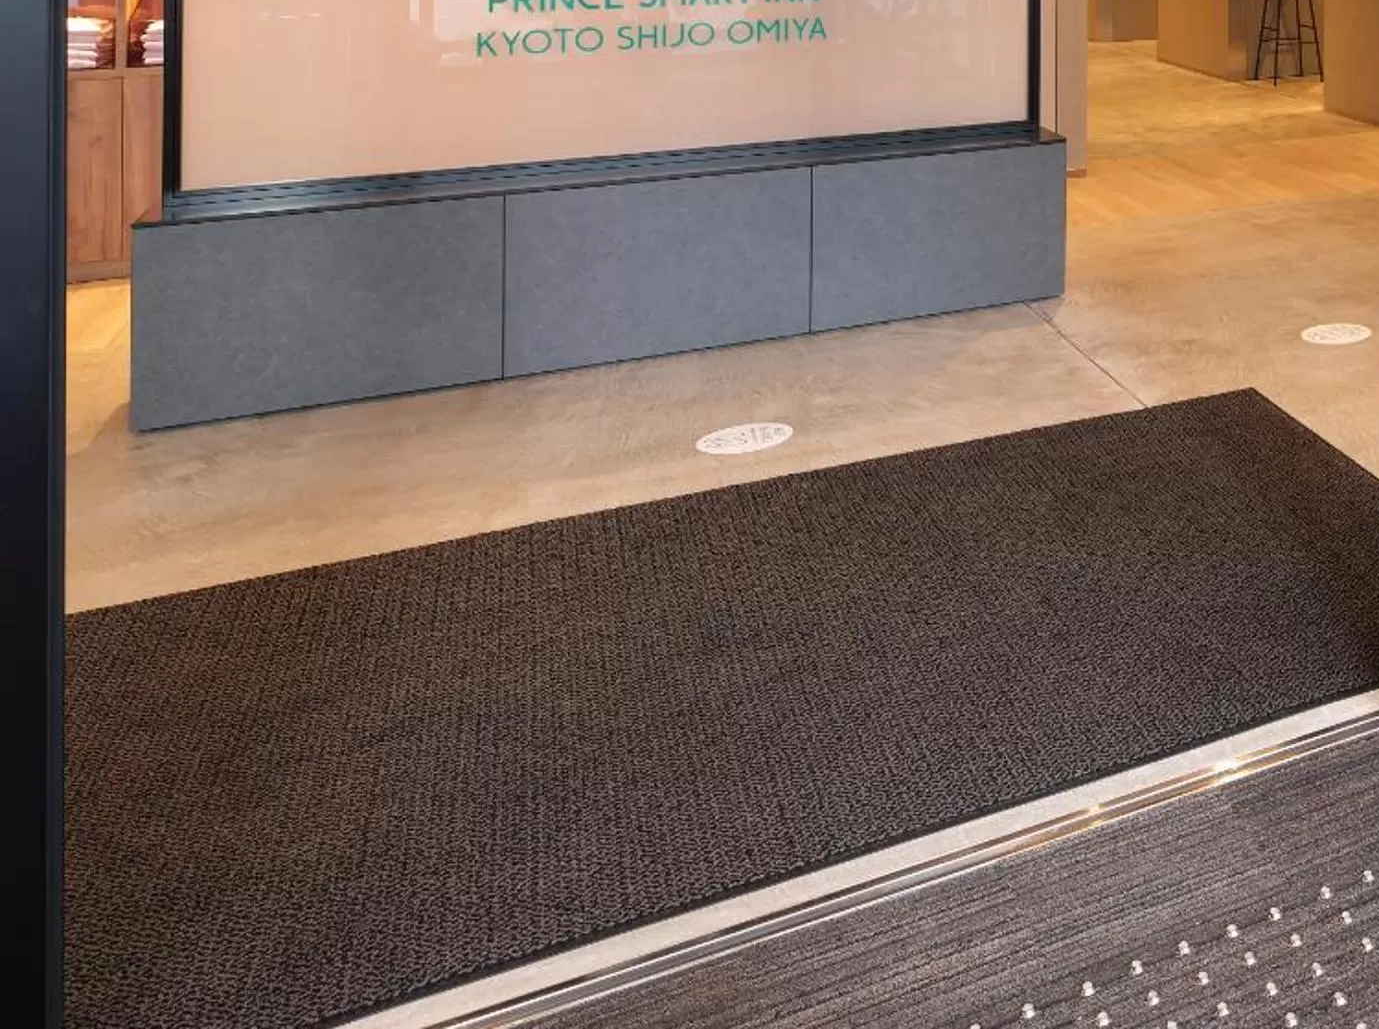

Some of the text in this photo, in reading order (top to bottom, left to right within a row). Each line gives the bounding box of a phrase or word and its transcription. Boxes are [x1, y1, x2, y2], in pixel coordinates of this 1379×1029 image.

[475, 16, 828, 58] KYOTO SHIJO OMIYA
